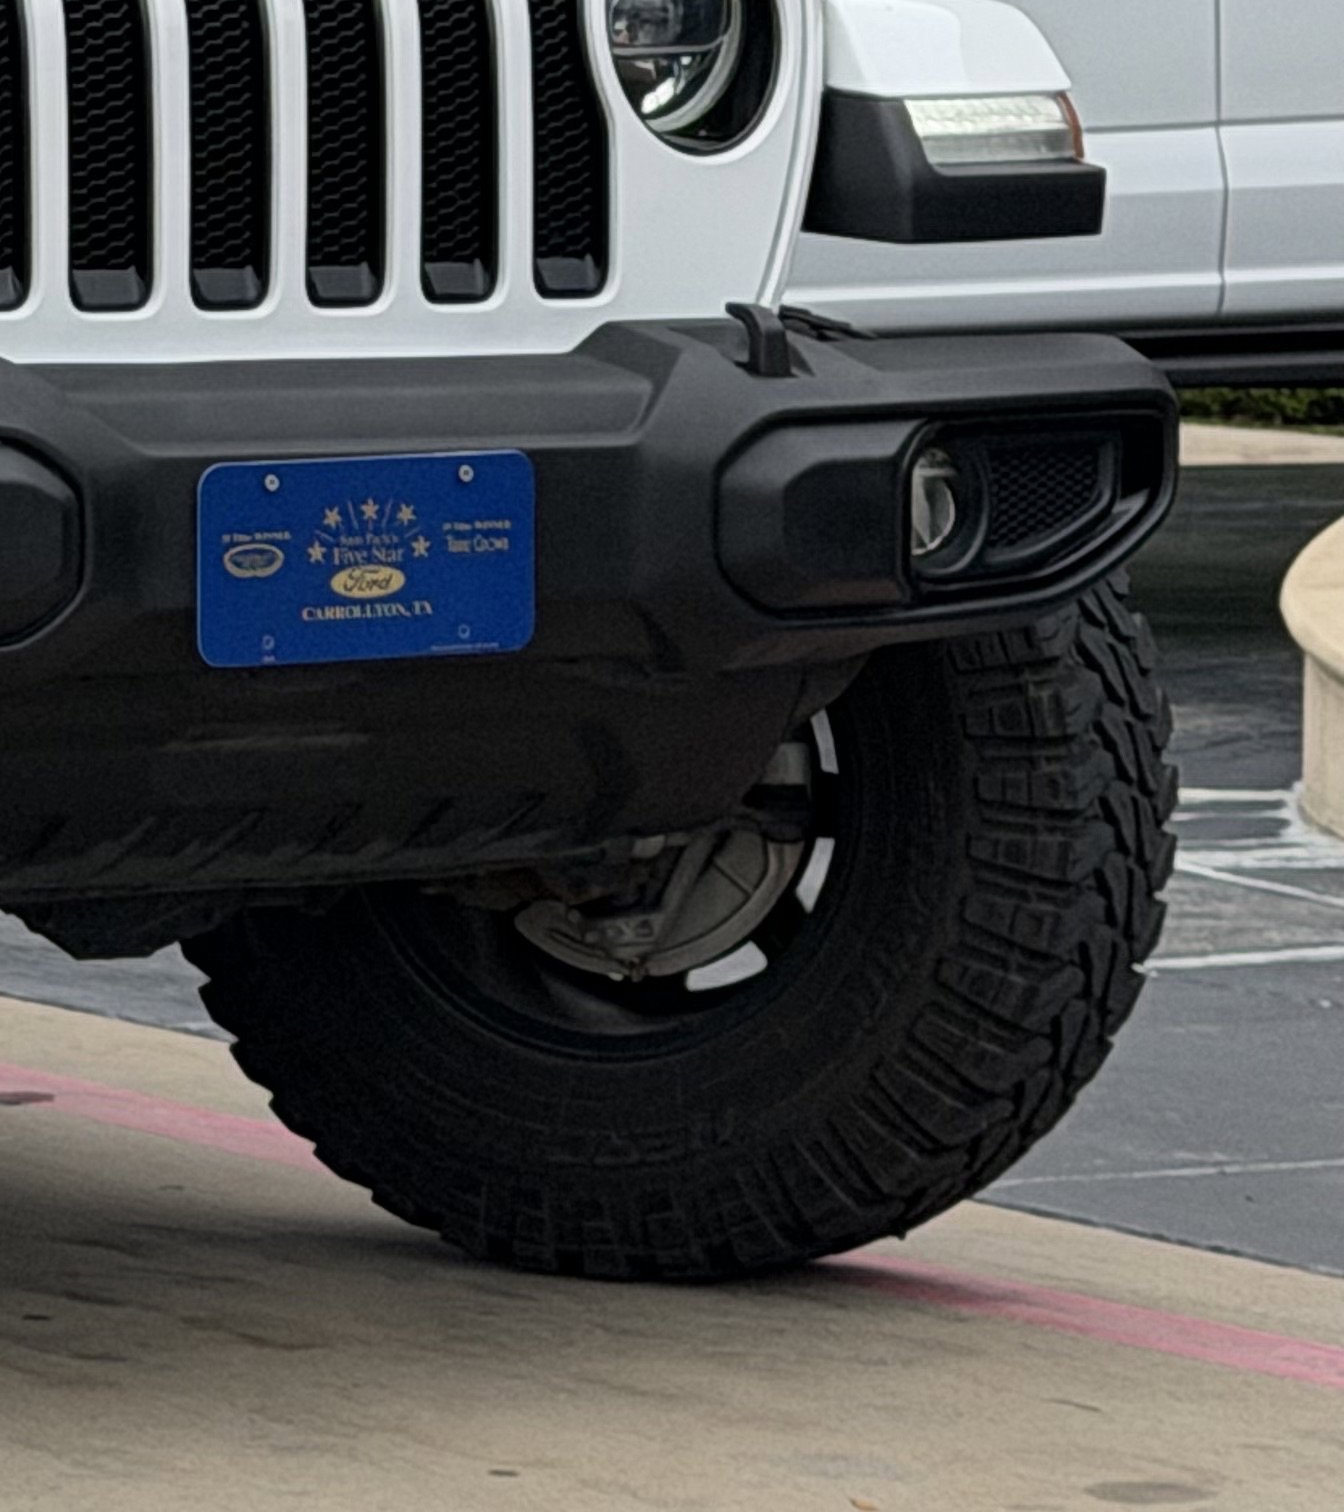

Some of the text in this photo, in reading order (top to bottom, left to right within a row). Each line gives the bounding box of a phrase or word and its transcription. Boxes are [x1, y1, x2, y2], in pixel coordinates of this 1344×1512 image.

[333, 544, 405, 566] Five Star
[340, 566, 396, 593] Ford
